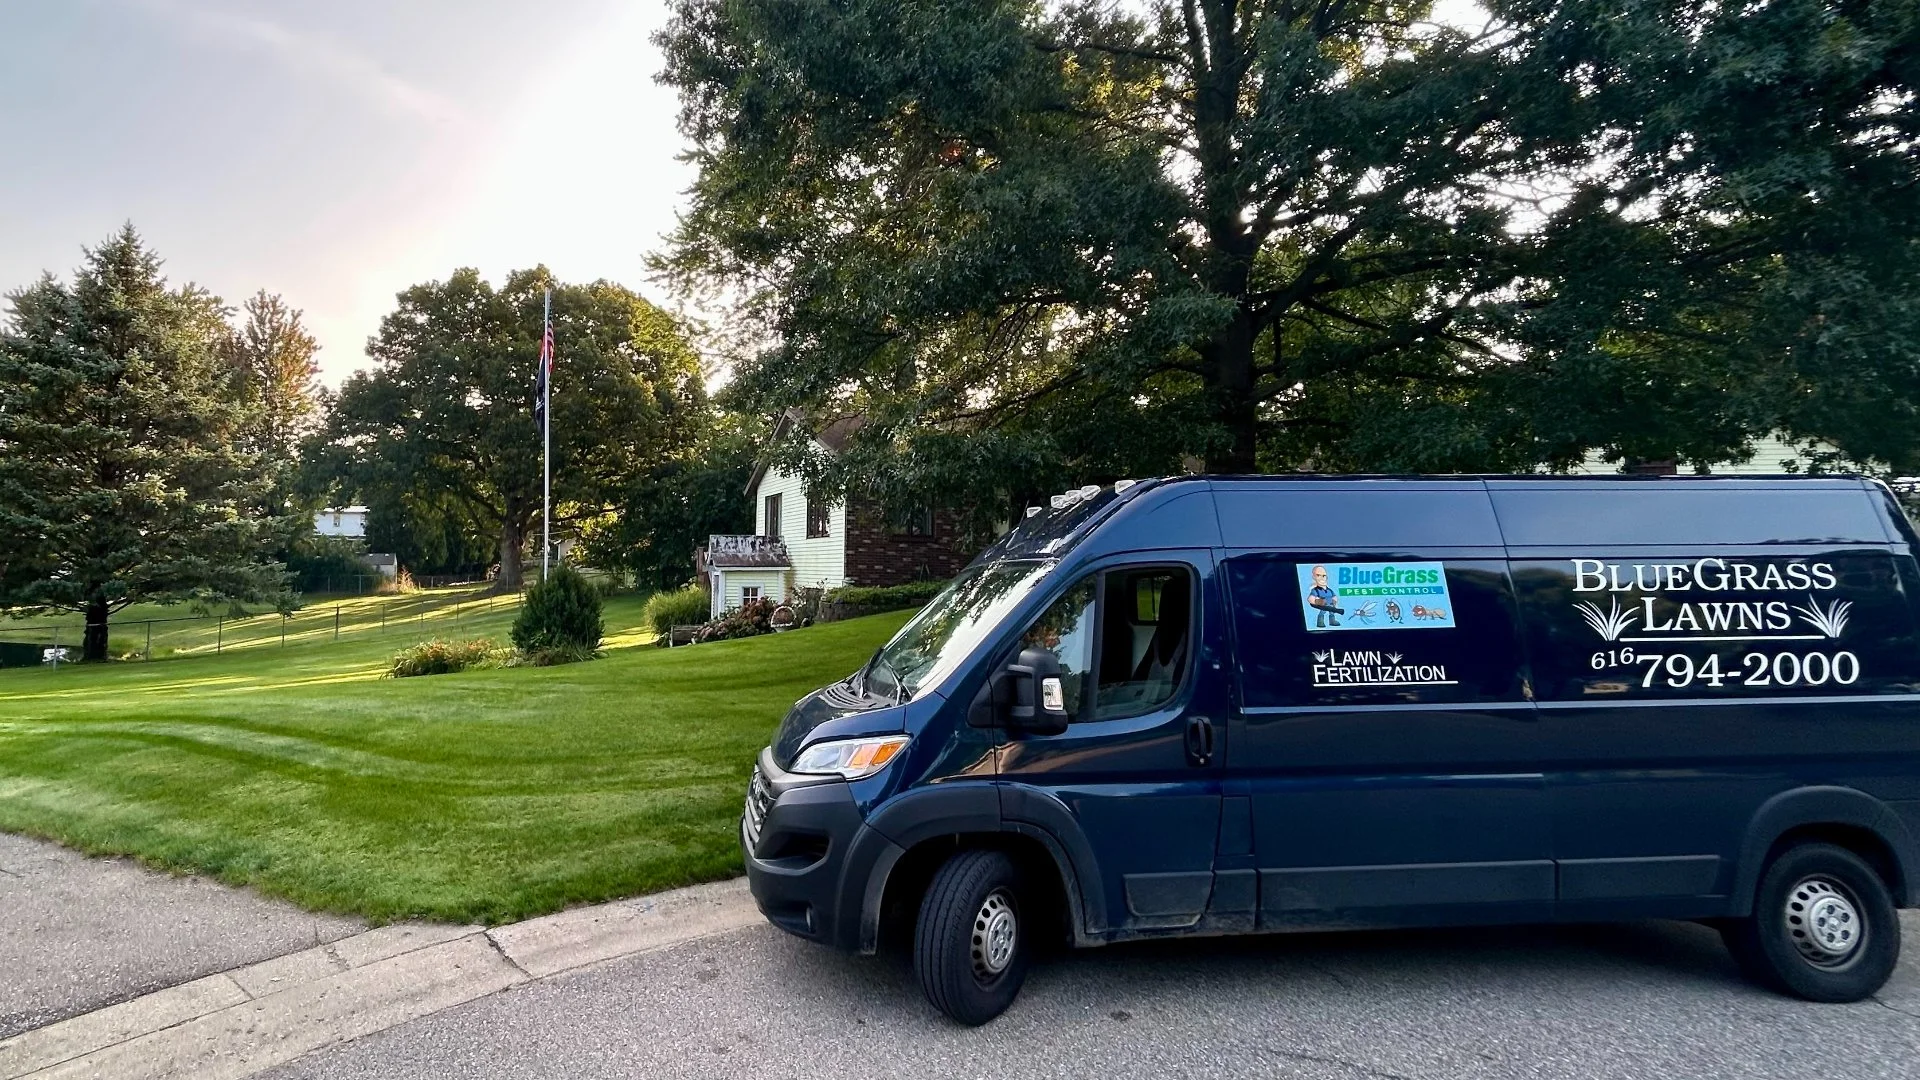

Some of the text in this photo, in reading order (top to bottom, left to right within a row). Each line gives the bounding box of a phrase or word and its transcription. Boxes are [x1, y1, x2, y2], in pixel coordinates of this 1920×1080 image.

[1338, 566, 1439, 585] BlueGrass
[1381, 586, 1437, 594] CONTROL
[1640, 596, 1791, 632] LAWNS
[1330, 648, 1382, 667] LAWN
[1313, 664, 1446, 683] FERTILIZATION
[1591, 647, 1860, 688] 616 794-2000
